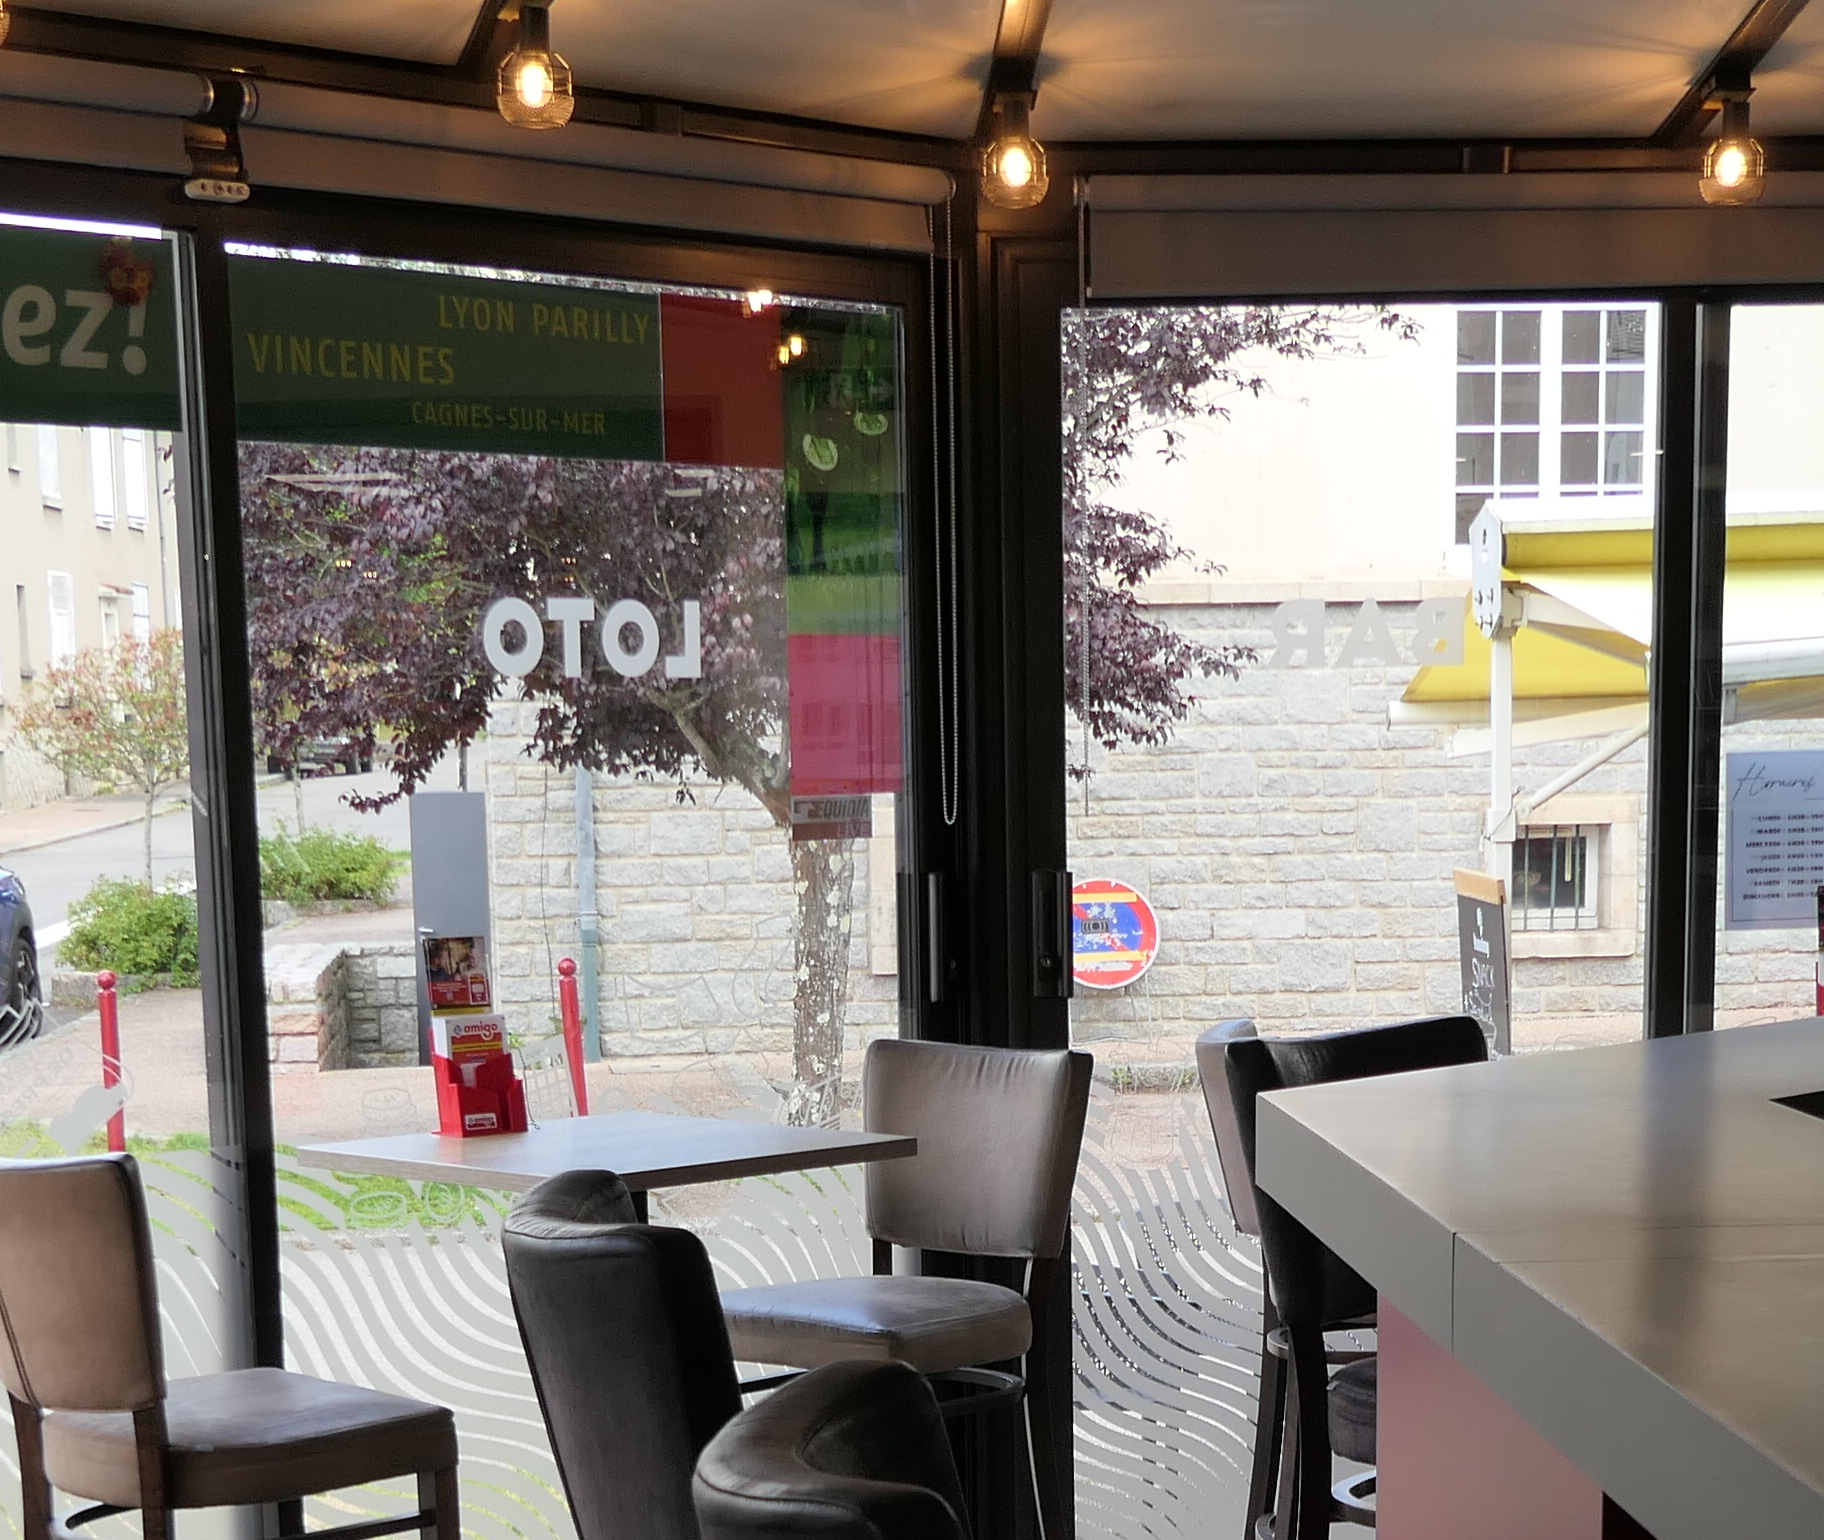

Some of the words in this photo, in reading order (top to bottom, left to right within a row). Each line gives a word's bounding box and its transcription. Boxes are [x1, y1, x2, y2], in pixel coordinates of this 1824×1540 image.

[439, 295, 515, 334] LYON
[533, 302, 650, 345] PARILLY
[247, 333, 456, 386] VINCENNES
[411, 401, 606, 436] CAGNES-SUR-MER
[836, 820, 870, 838] LIVE
[464, 1019, 499, 1040] amigo
